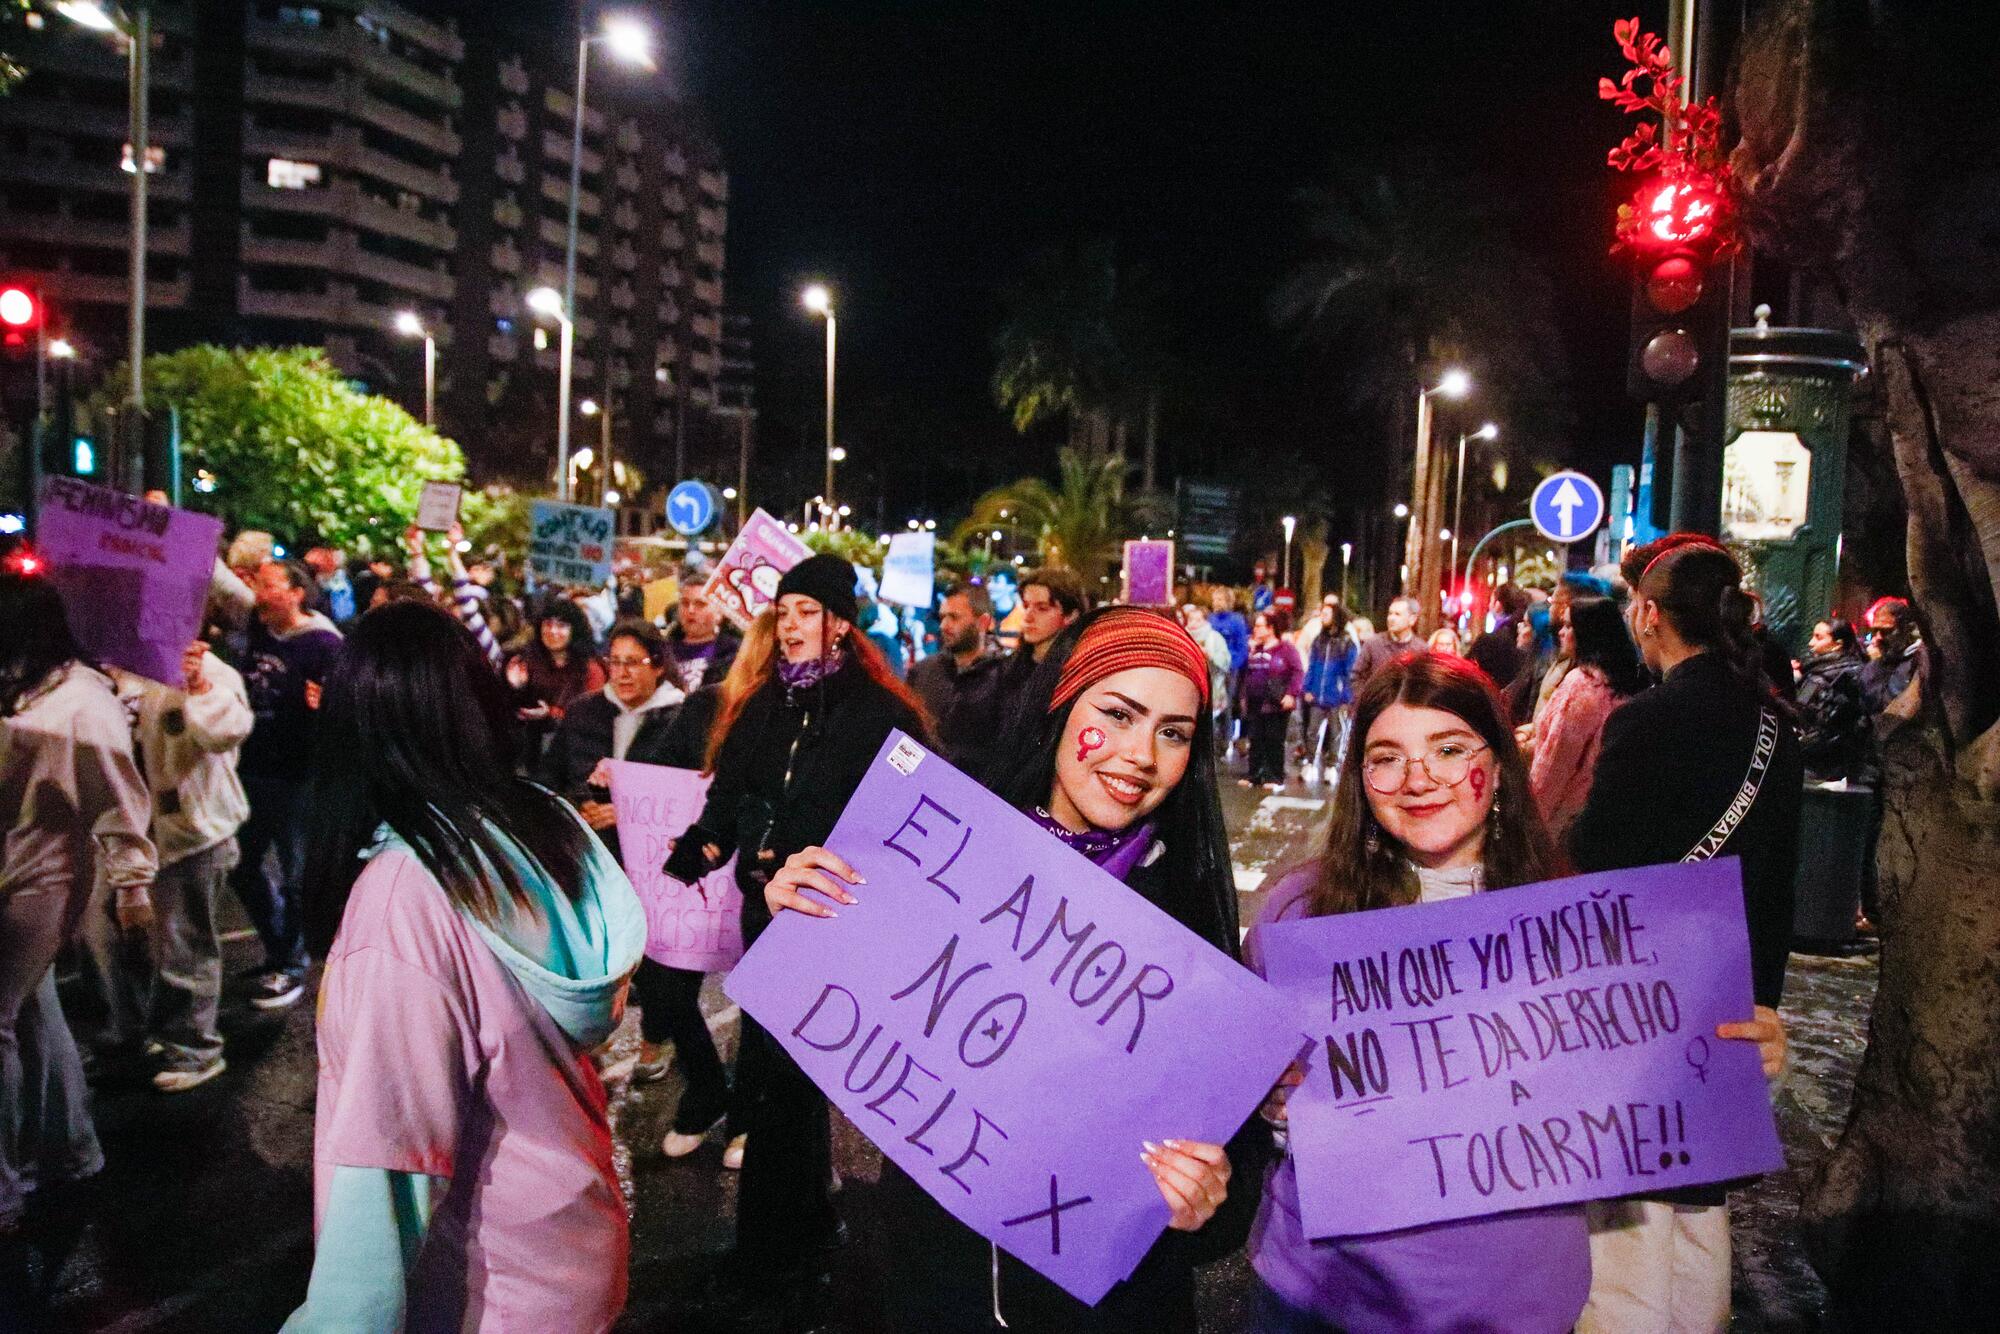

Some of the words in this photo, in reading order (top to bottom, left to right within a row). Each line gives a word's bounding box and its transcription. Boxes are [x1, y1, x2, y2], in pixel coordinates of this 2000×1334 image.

[882, 794, 972, 904] EL
[979, 874, 1175, 1054] AMOR
[1469, 932, 1514, 990] YO
[889, 933, 1028, 1068] NO
[1324, 1027, 1390, 1100] NO
[1390, 1014, 1470, 1093] TE
[1467, 1011, 1530, 1079] DA
[1518, 979, 1681, 1062] DERECHO
[791, 984, 1009, 1195] DUELE
[1509, 1079, 1532, 1107] A
